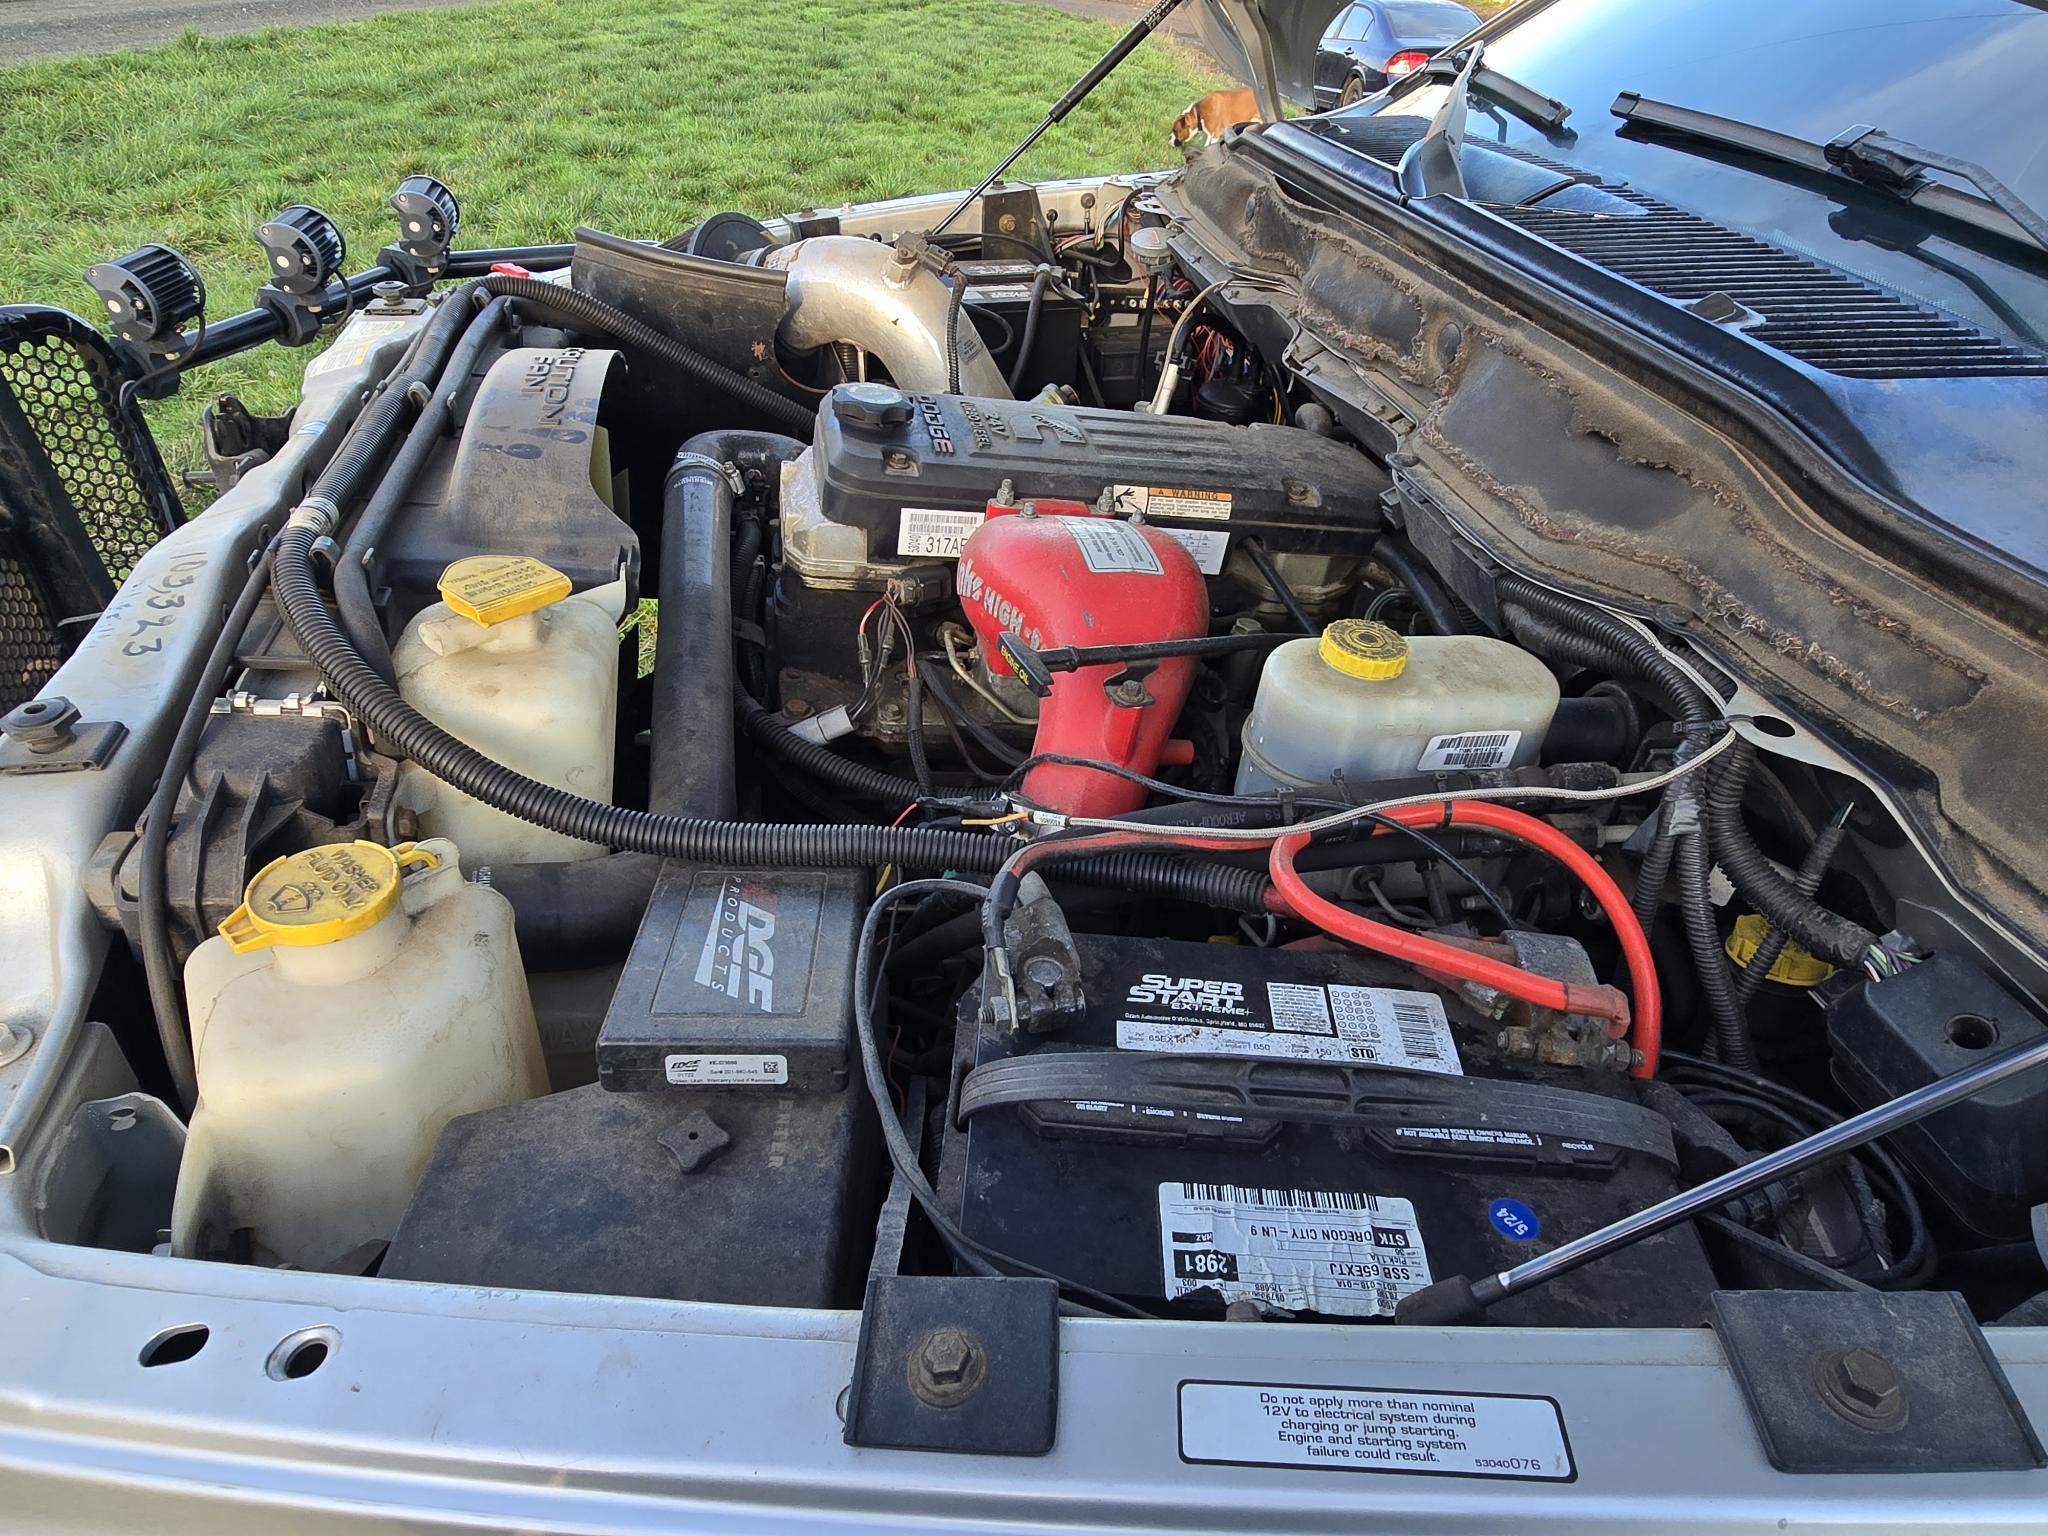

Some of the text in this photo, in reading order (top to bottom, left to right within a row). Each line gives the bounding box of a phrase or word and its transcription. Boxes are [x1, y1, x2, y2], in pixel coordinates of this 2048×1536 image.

[916, 395, 955, 455] DODGE
[984, 412, 1009, 439] 24V
[1172, 489, 1218, 500] WARNING
[1001, 646, 1029, 685] ENGINE OIL
[330, 849, 381, 893] WASHER
[304, 851, 366, 910] FLUID ONLY
[711, 876, 741, 993] PRODUCTS
[1141, 974, 1243, 995] SUPER
[1126, 985, 1245, 1009] START
[1351, 1047, 1375, 1059] STD
[1419, 1131, 1451, 1140] AVAILABLE
[1469, 1135, 1495, 1143] SERVICE
[1561, 1142, 1595, 1151] RECYCLE
[1194, 1233, 1212, 1241] HAZ
[1250, 1225, 1257, 1237] 9
[1323, 1229, 1372, 1242] OREGON
[1376, 1231, 1405, 1246] STK
[1184, 1252, 1228, 1273] 2981
[1388, 1255, 1407, 1264] Pick
[1330, 1263, 1410, 1280] SSB 65EXTJ
[1182, 1278, 1197, 1286] 003
[1260, 1392, 1475, 1413] Do not apply more than nominal
[1263, 1406, 1476, 1427] 12V to electrical system during
[1281, 1419, 1459, 1439] charging or jump starting.
[1278, 1431, 1466, 1452] Engine and starting system
[1307, 1445, 1440, 1462] failure could result.
[1475, 1457, 1541, 1470] 53040076
